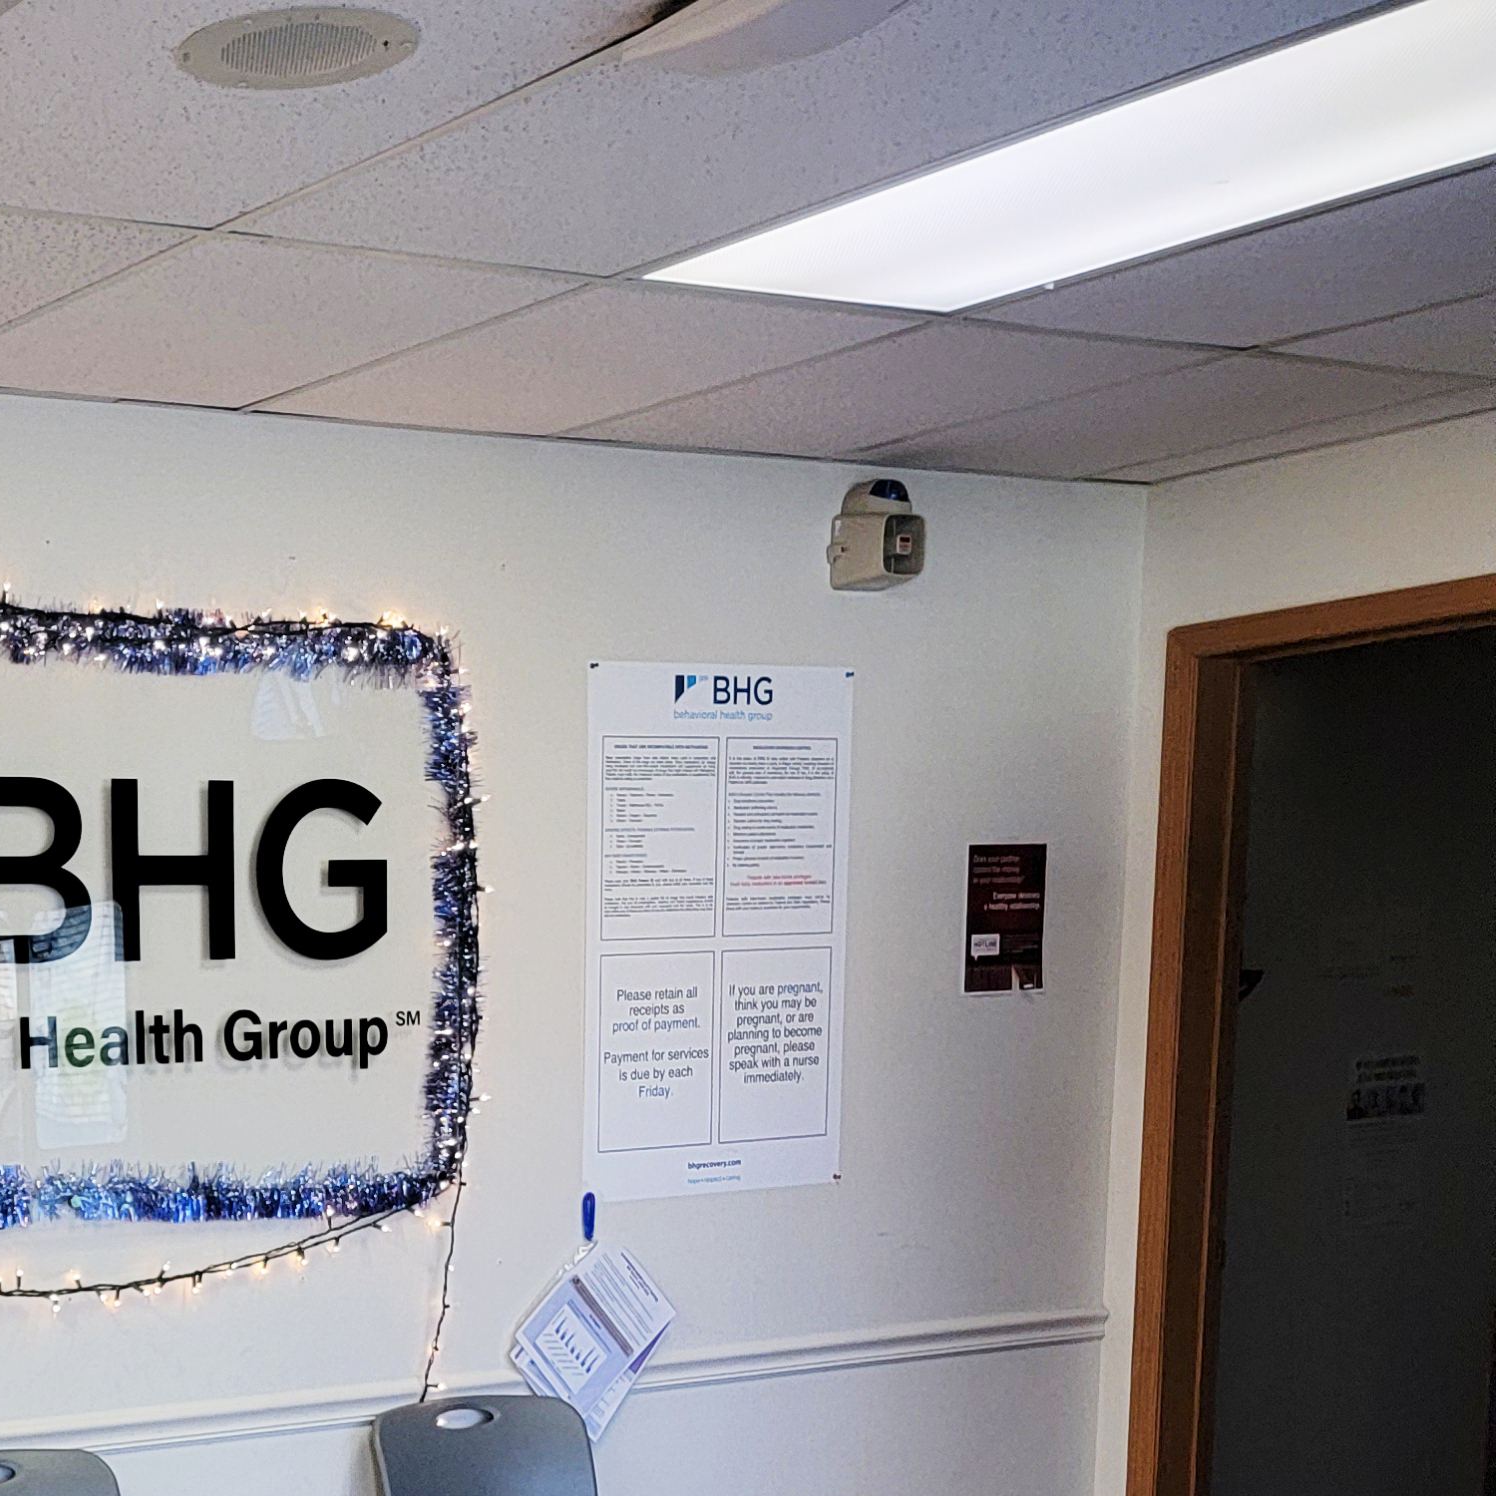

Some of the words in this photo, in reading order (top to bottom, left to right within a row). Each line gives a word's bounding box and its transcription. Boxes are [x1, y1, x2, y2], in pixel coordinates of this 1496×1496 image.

[713, 675, 773, 705] BHG
[673, 709, 717, 720] behavioral
[720, 710, 745, 720] health
[747, 712, 773, 722] group
[617, 989, 651, 1001] Please
[655, 987, 683, 1000] retain
[686, 986, 698, 998] all
[729, 984, 735, 997] If
[738, 986, 756, 1000] you
[759, 985, 774, 995] are
[778, 981, 823, 996] pregnant,
[629, 1003, 669, 1017] receipts
[673, 1004, 684, 1014] as
[735, 998, 758, 1011] think
[761, 999, 778, 1012] you
[781, 999, 802, 1010] may
[805, 996, 817, 1007] be
[612, 1019, 639, 1035] proof
[642, 1018, 651, 1030] of
[654, 1017, 701, 1032] payment.
[737, 1013, 782, 1029] pregnant,
[786, 1014, 796, 1023] or
[798, 1013, 814, 1022] are
[19, 1009, 204, 1069] Health
[224, 1009, 388, 1069] Group
[395, 1010, 421, 1026] SM
[728, 1029, 769, 1043] planning
[772, 1027, 781, 1038] to
[784, 1026, 822, 1037] become
[604, 1051, 648, 1066] Payment
[652, 1049, 665, 1061] for
[668, 1047, 709, 1060] services
[734, 1042, 780, 1058] pregnant,
[783, 1041, 815, 1055] please
[729, 1057, 758, 1072] speak
[762, 1056, 781, 1068] with
[784, 1058, 789, 1066] a
[793, 1056, 819, 1066] nurse
[619, 1069, 627, 1081] is
[630, 1068, 649, 1080] due
[653, 1067, 665, 1082] by
[668, 1065, 693, 1078] each
[744, 1069, 804, 1083] immediately.
[639, 1084, 673, 1099] Friday.
[687, 1159, 741, 1170] bhgrecovery.com
